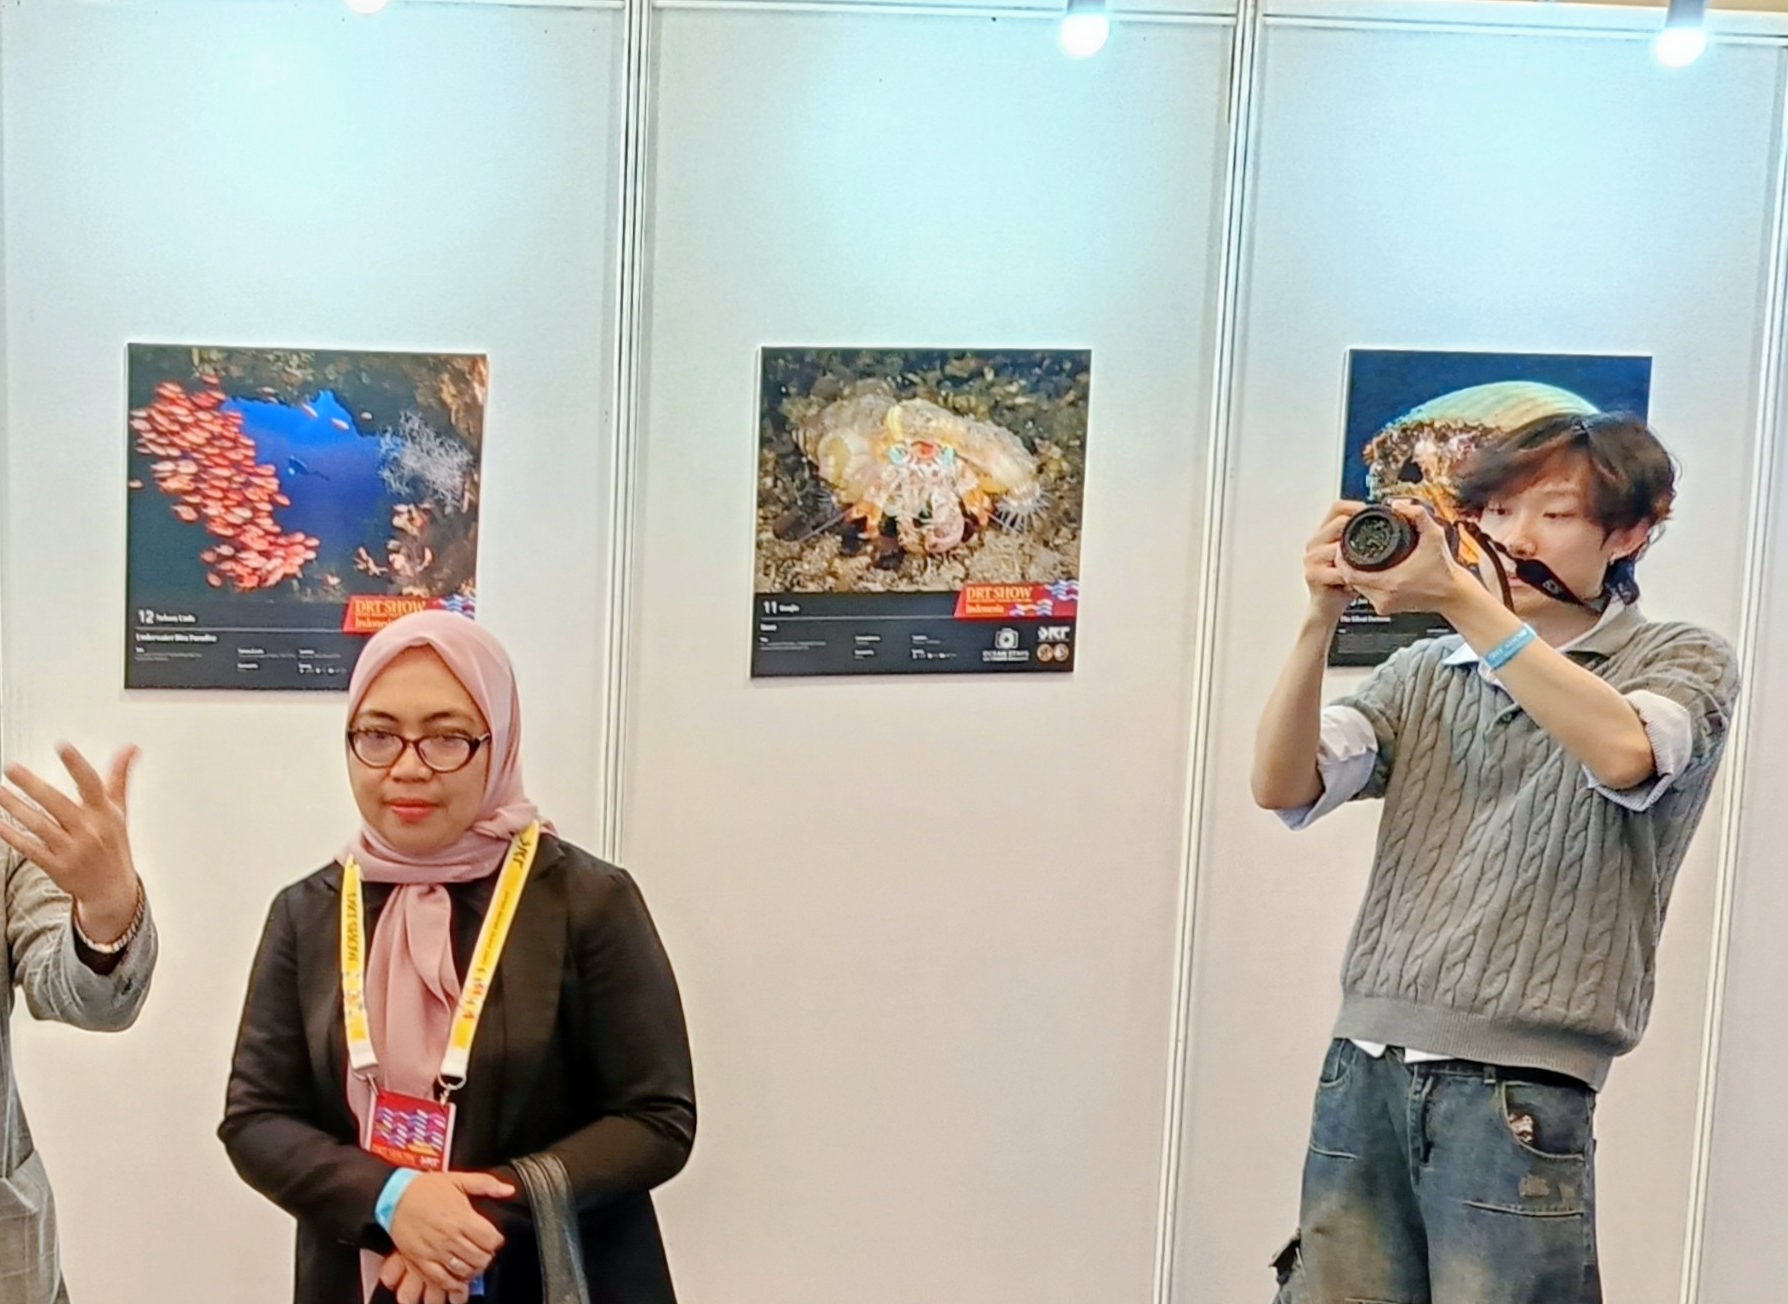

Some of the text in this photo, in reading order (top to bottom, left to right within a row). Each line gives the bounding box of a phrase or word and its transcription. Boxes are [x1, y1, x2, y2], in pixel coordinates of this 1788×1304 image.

[966, 586, 1032, 599] DRT SHOW
[763, 601, 777, 614] 11
[138, 609, 154, 624] 12
